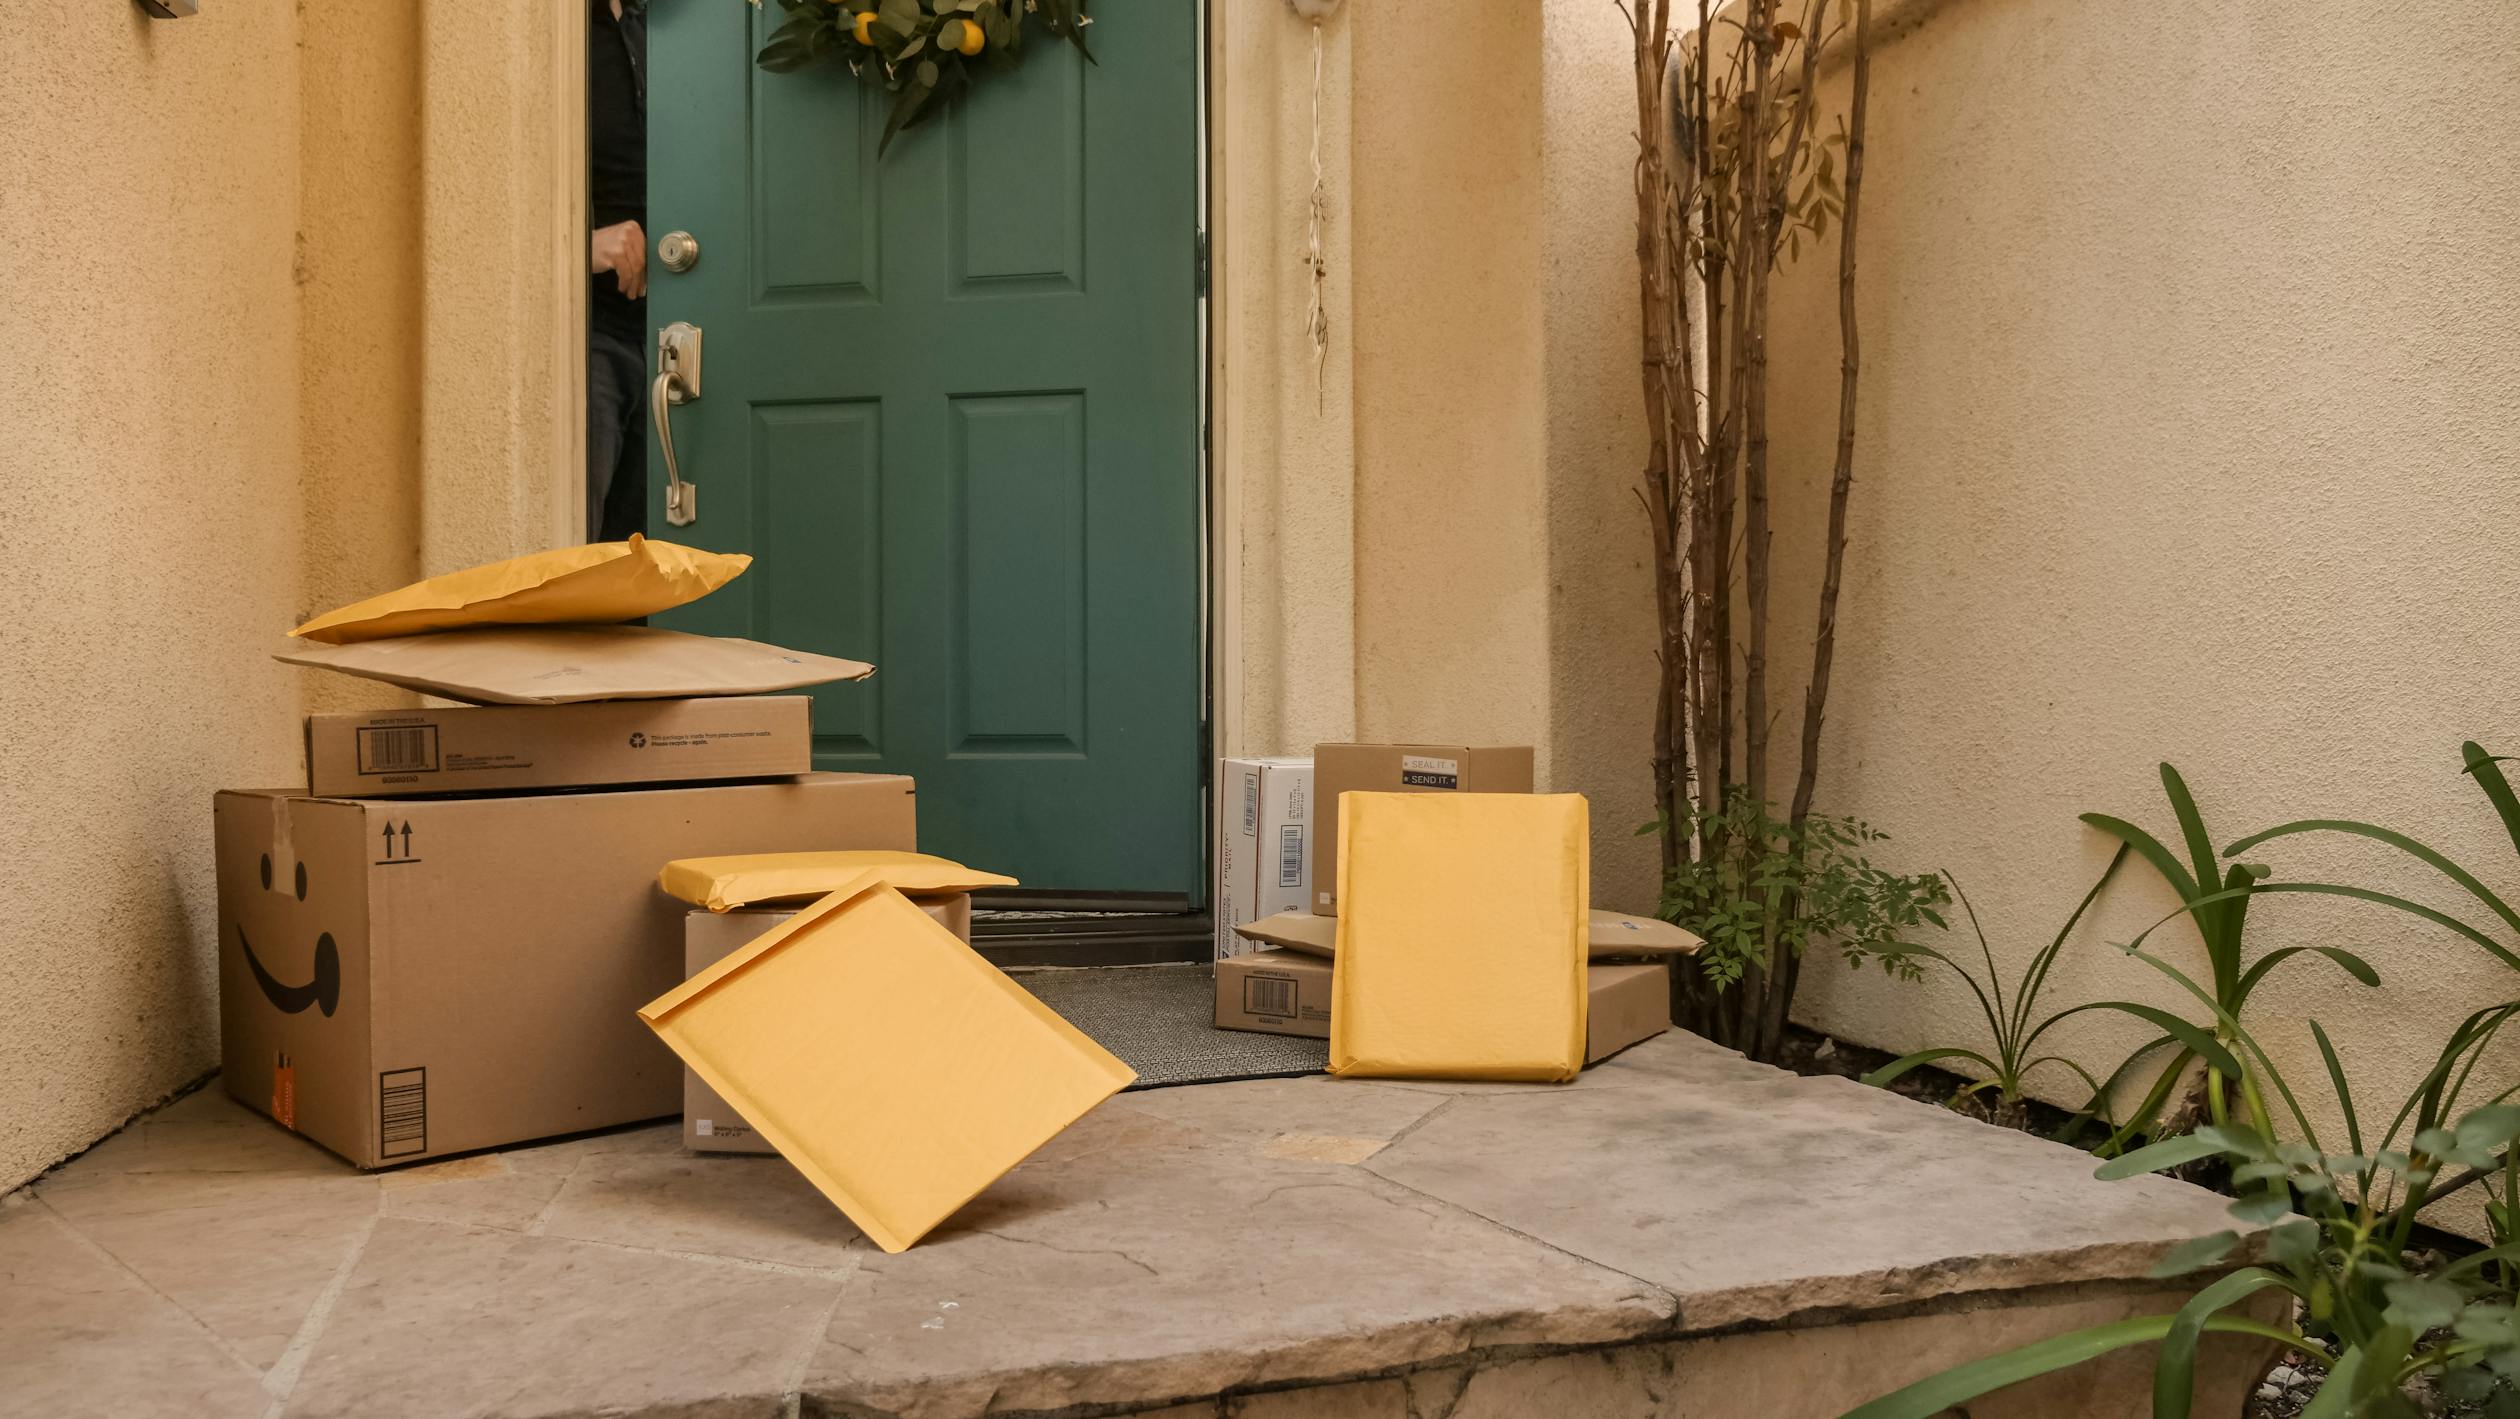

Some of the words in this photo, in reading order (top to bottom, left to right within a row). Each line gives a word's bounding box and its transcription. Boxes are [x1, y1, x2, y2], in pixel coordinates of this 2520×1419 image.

[1411, 760, 1435, 769] SEAL
[1437, 760, 1448, 769] IT.
[1411, 775, 1437, 784] SEND
[1438, 776, 1449, 784] IT.
